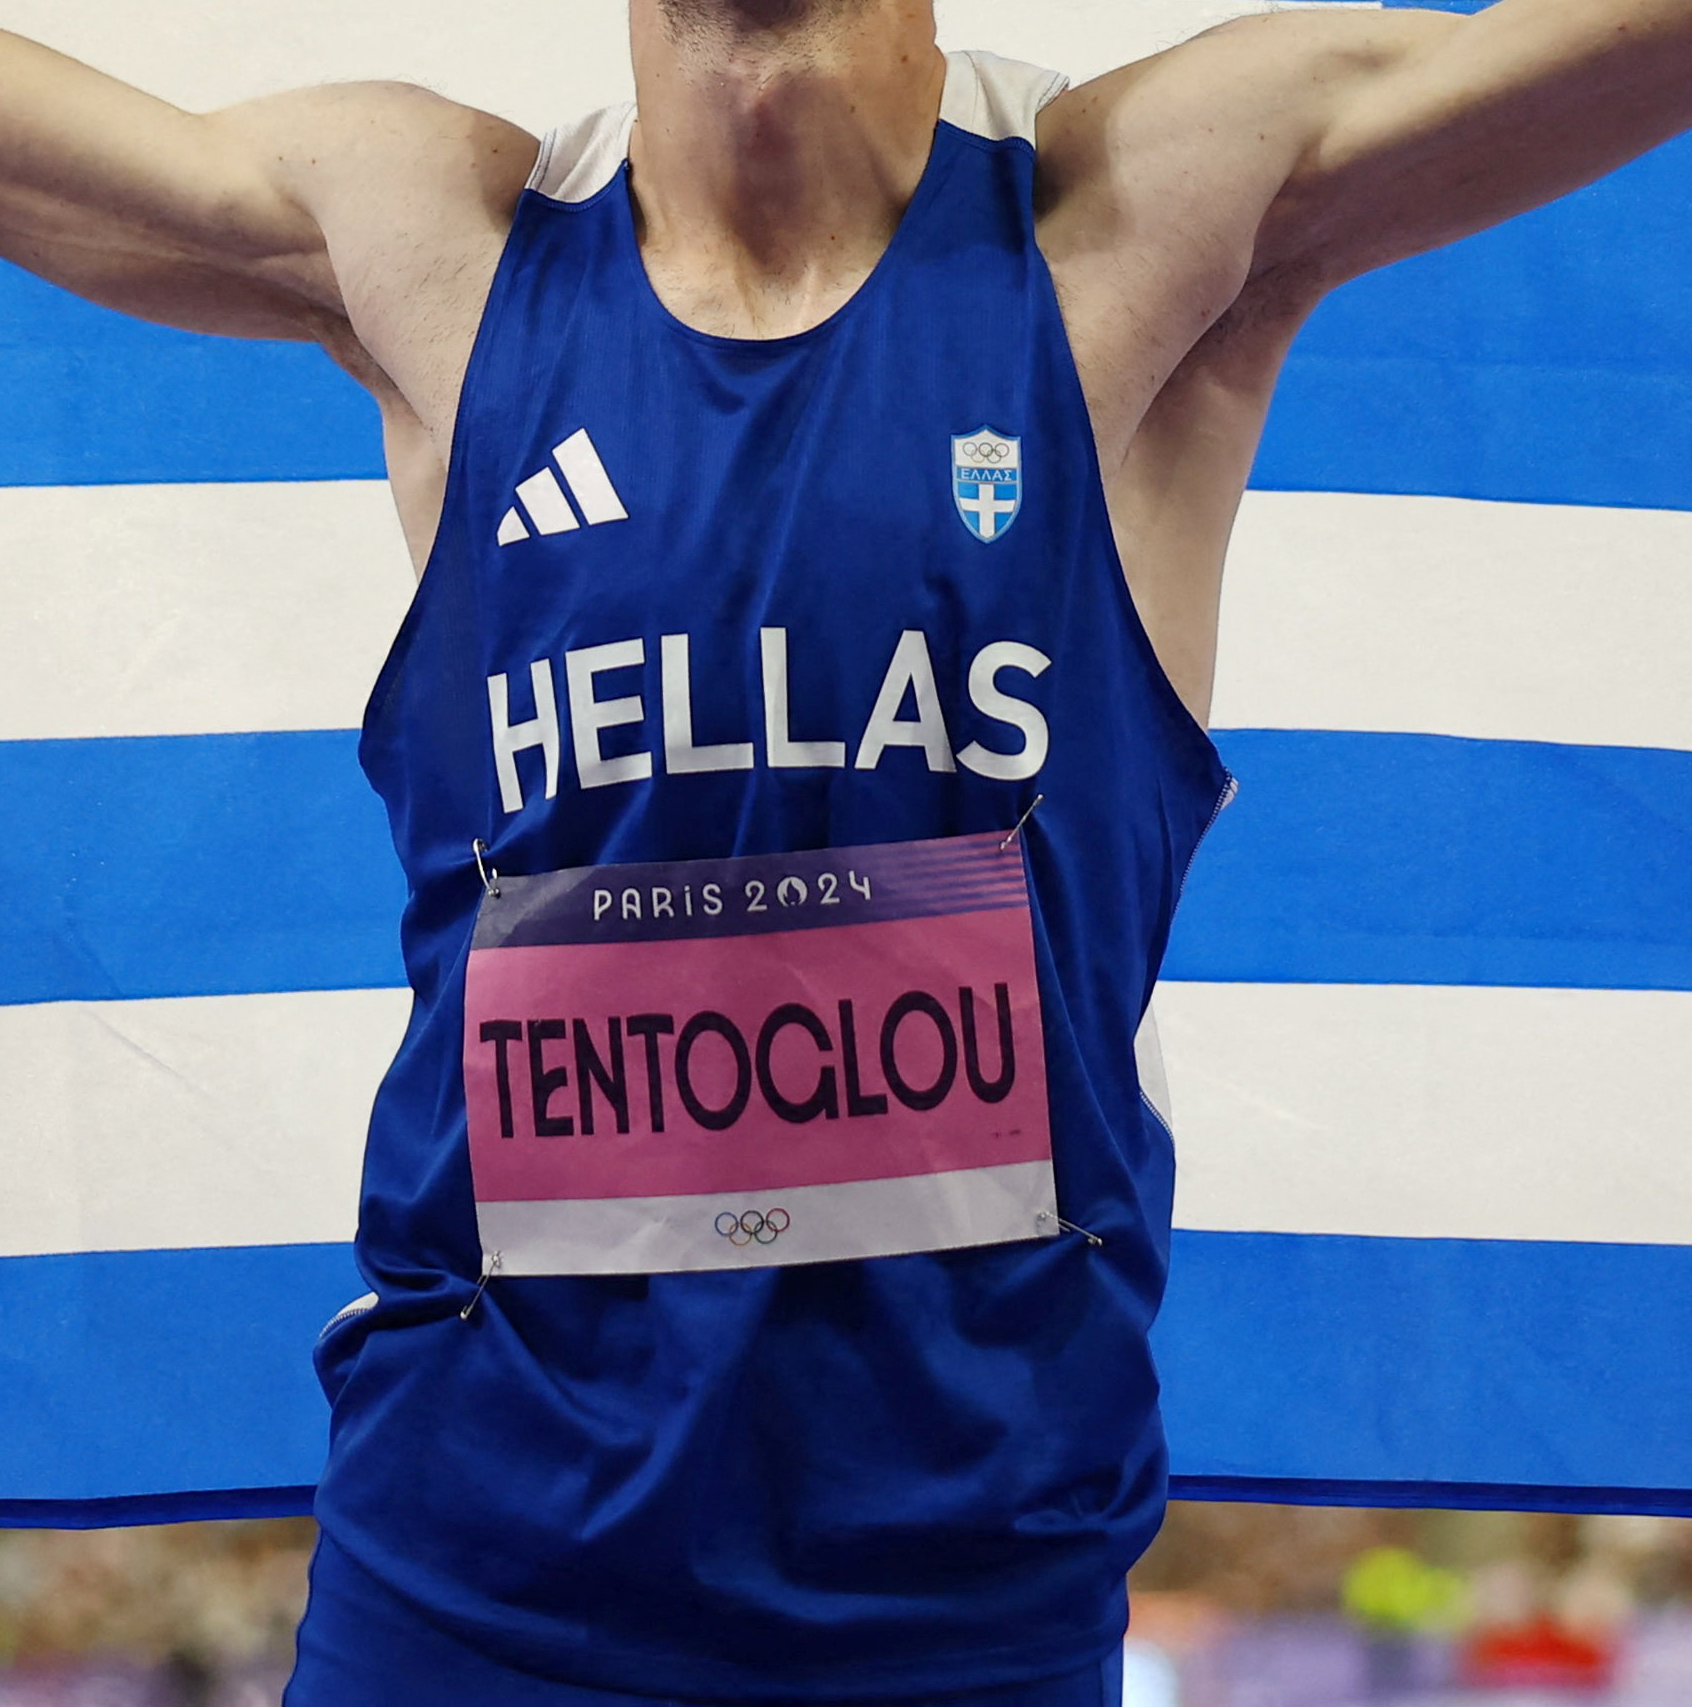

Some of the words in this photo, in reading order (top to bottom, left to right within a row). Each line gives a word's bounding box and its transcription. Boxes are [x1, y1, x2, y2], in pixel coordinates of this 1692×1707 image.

[961, 468, 1012, 481] ΕΛΛΑΣ
[487, 626, 1052, 814] HELLAS
[744, 870, 872, 912] 2024
[479, 982, 1016, 1139] TENTOGLOU
